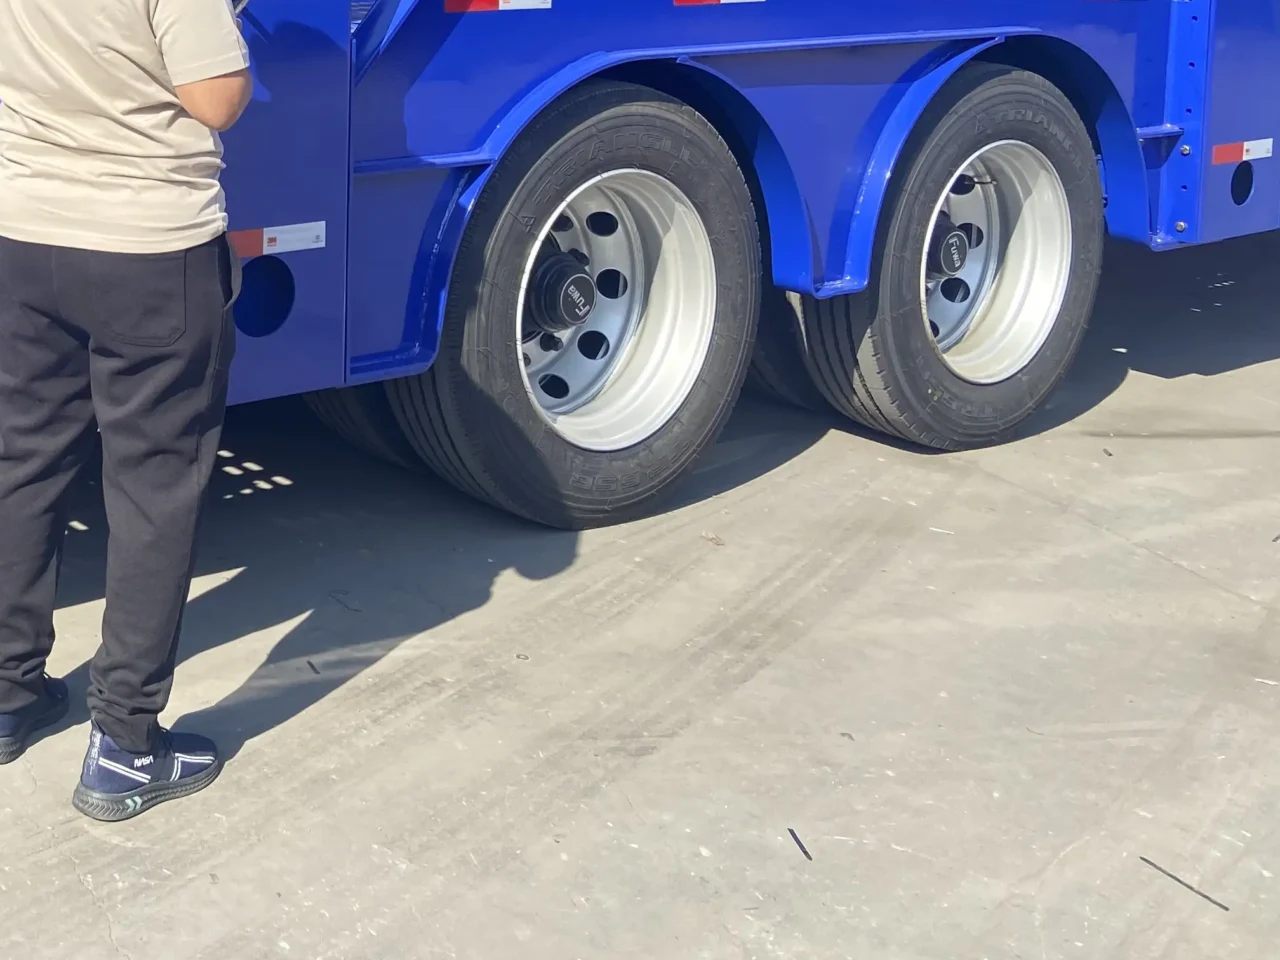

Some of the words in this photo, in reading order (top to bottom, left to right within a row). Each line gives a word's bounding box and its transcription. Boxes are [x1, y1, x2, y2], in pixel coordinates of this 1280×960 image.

[948, 236, 961, 268] Fuwa
[567, 284, 591, 317] Fuwa
[134, 755, 154, 768] NASA
